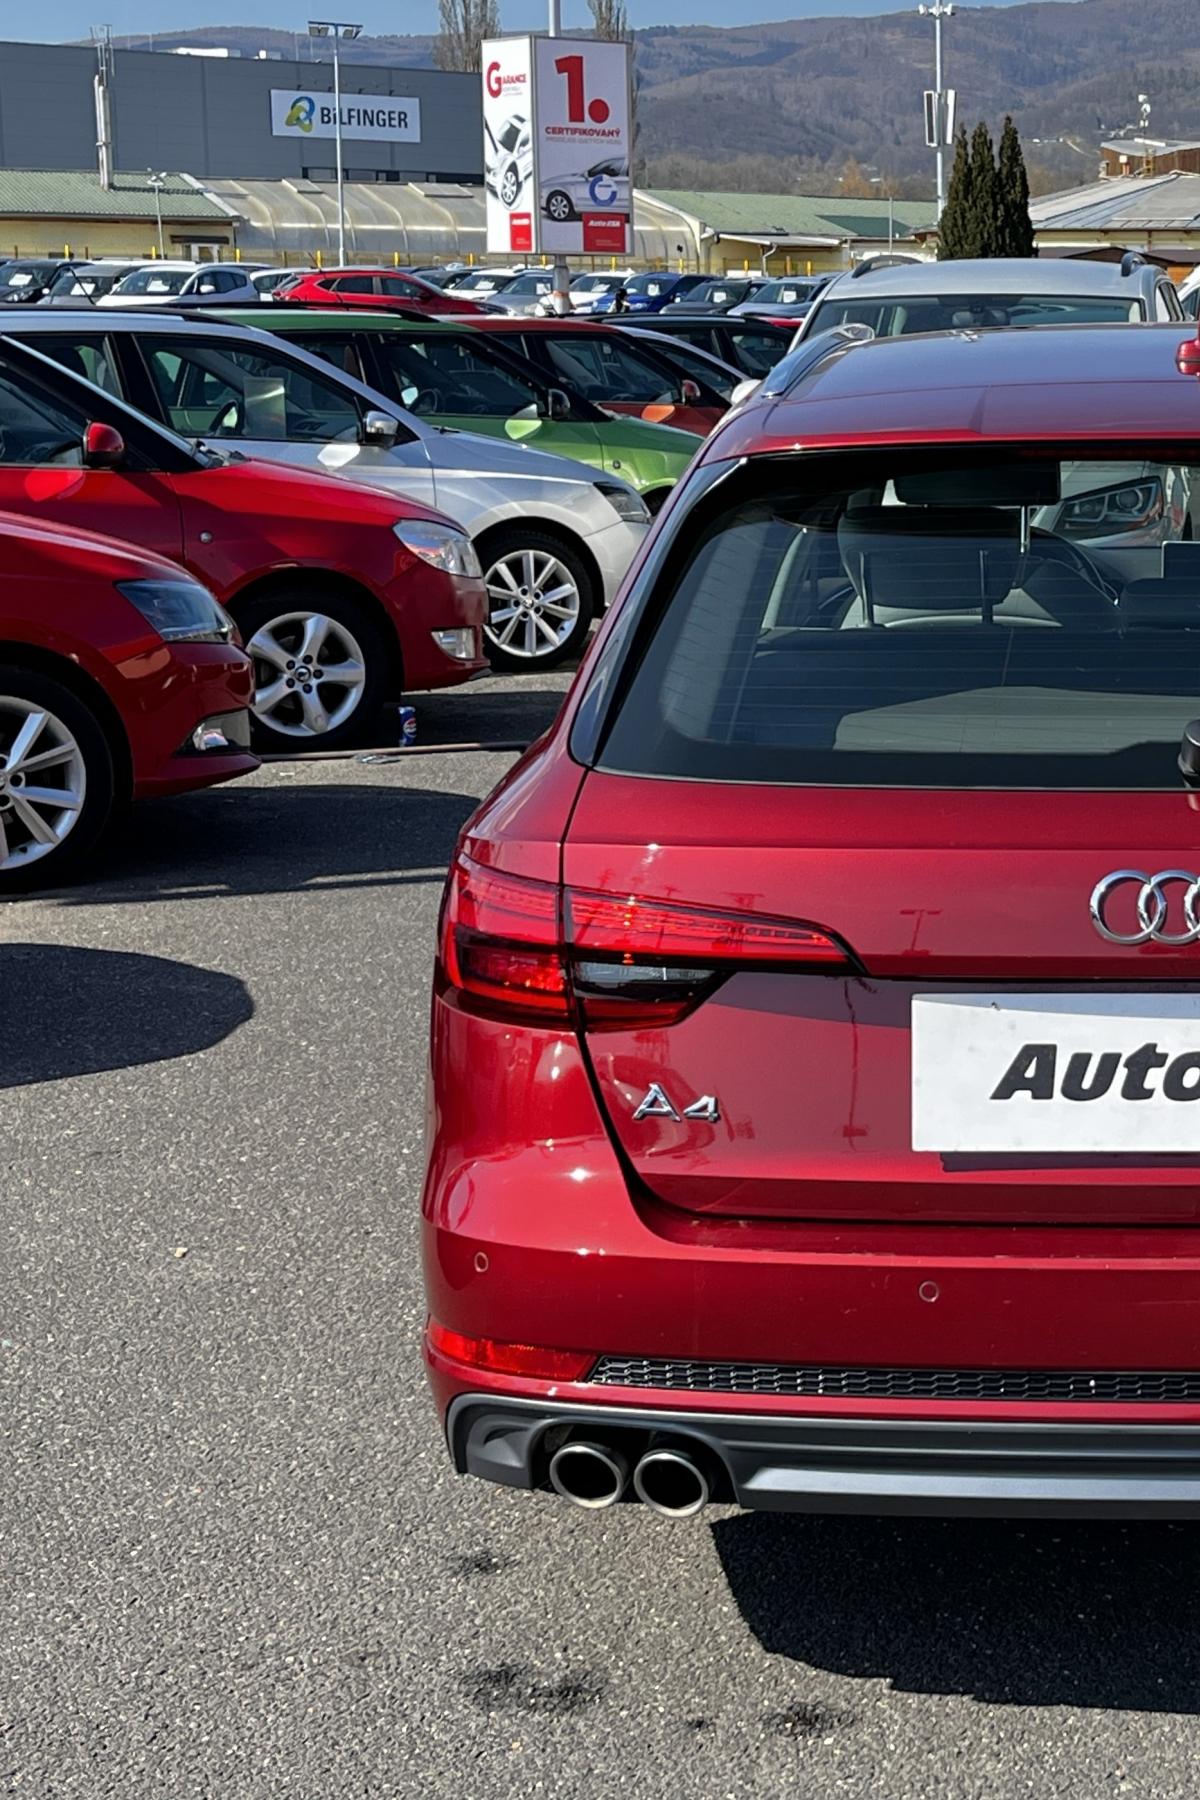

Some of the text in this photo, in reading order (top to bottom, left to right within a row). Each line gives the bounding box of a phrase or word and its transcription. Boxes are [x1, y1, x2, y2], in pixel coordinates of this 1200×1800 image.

[555, 55, 609, 123] 1.
[320, 107, 408, 128] BILFINGER
[545, 126, 621, 137] CERTIFIKOVANÝ
[632, 1082, 721, 1123] A4
